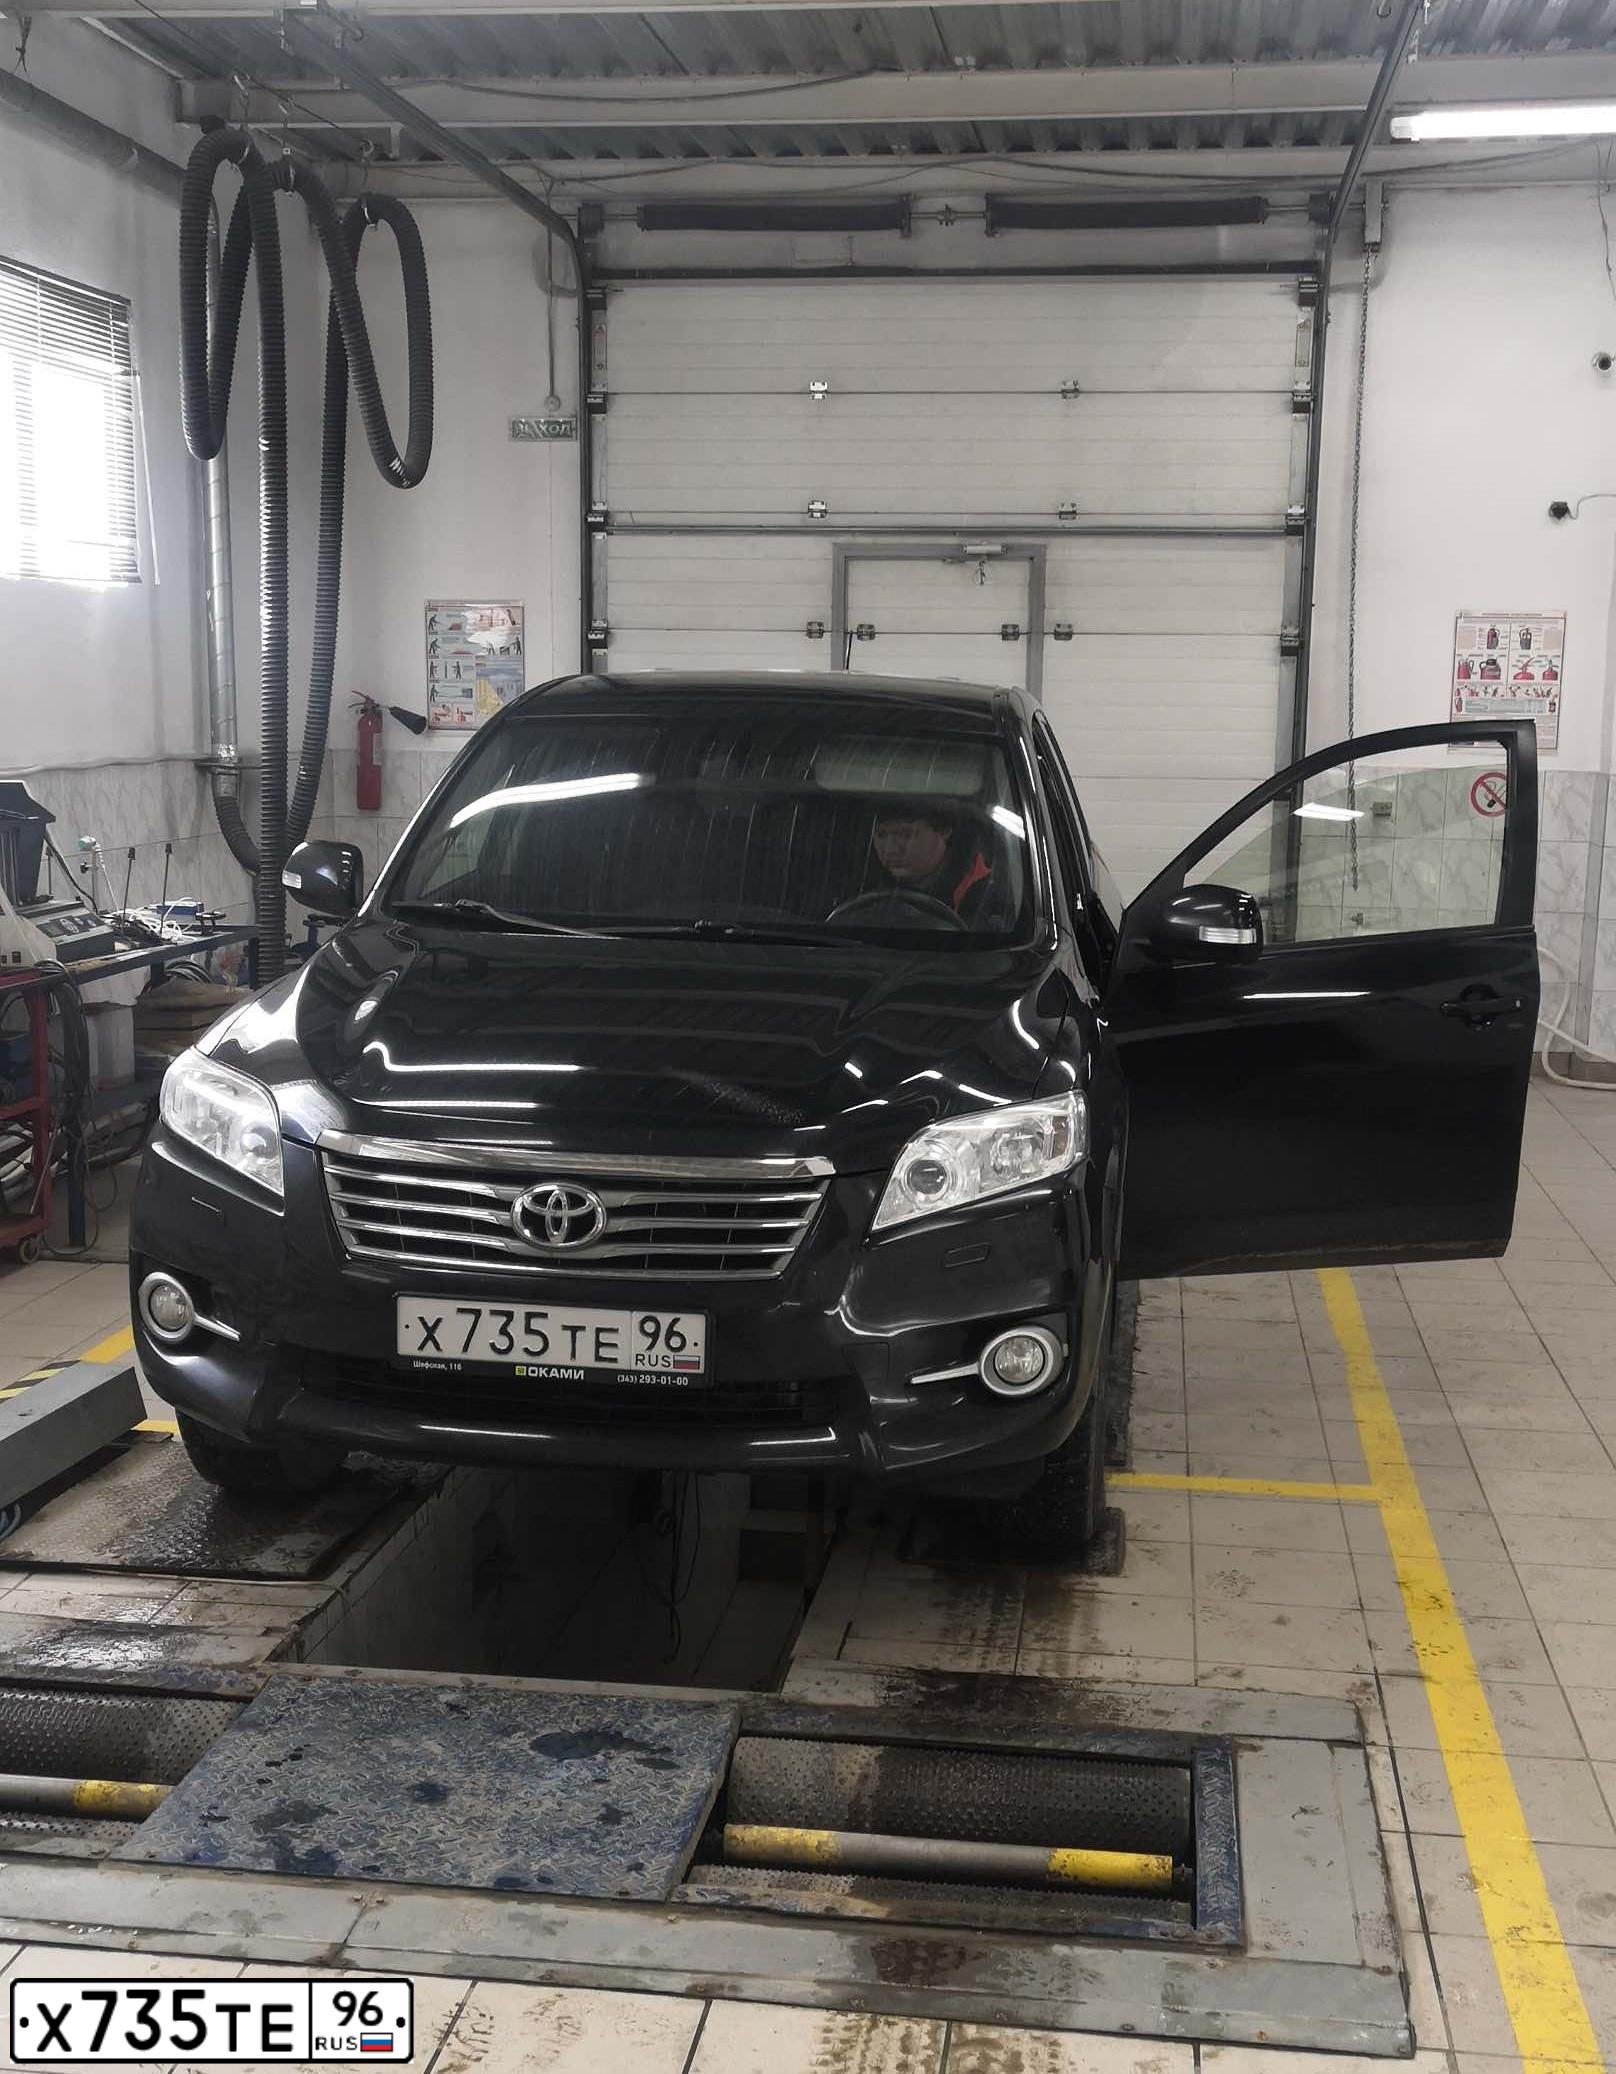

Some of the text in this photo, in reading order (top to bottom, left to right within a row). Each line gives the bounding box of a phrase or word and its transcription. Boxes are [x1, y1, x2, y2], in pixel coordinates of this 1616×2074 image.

[639, 1315, 687, 1352] 96
[635, 1354, 671, 1369] RUS
[527, 1367, 584, 1380] ОКАМИ
[617, 1374, 688, 1386] (343) 293-01-00
